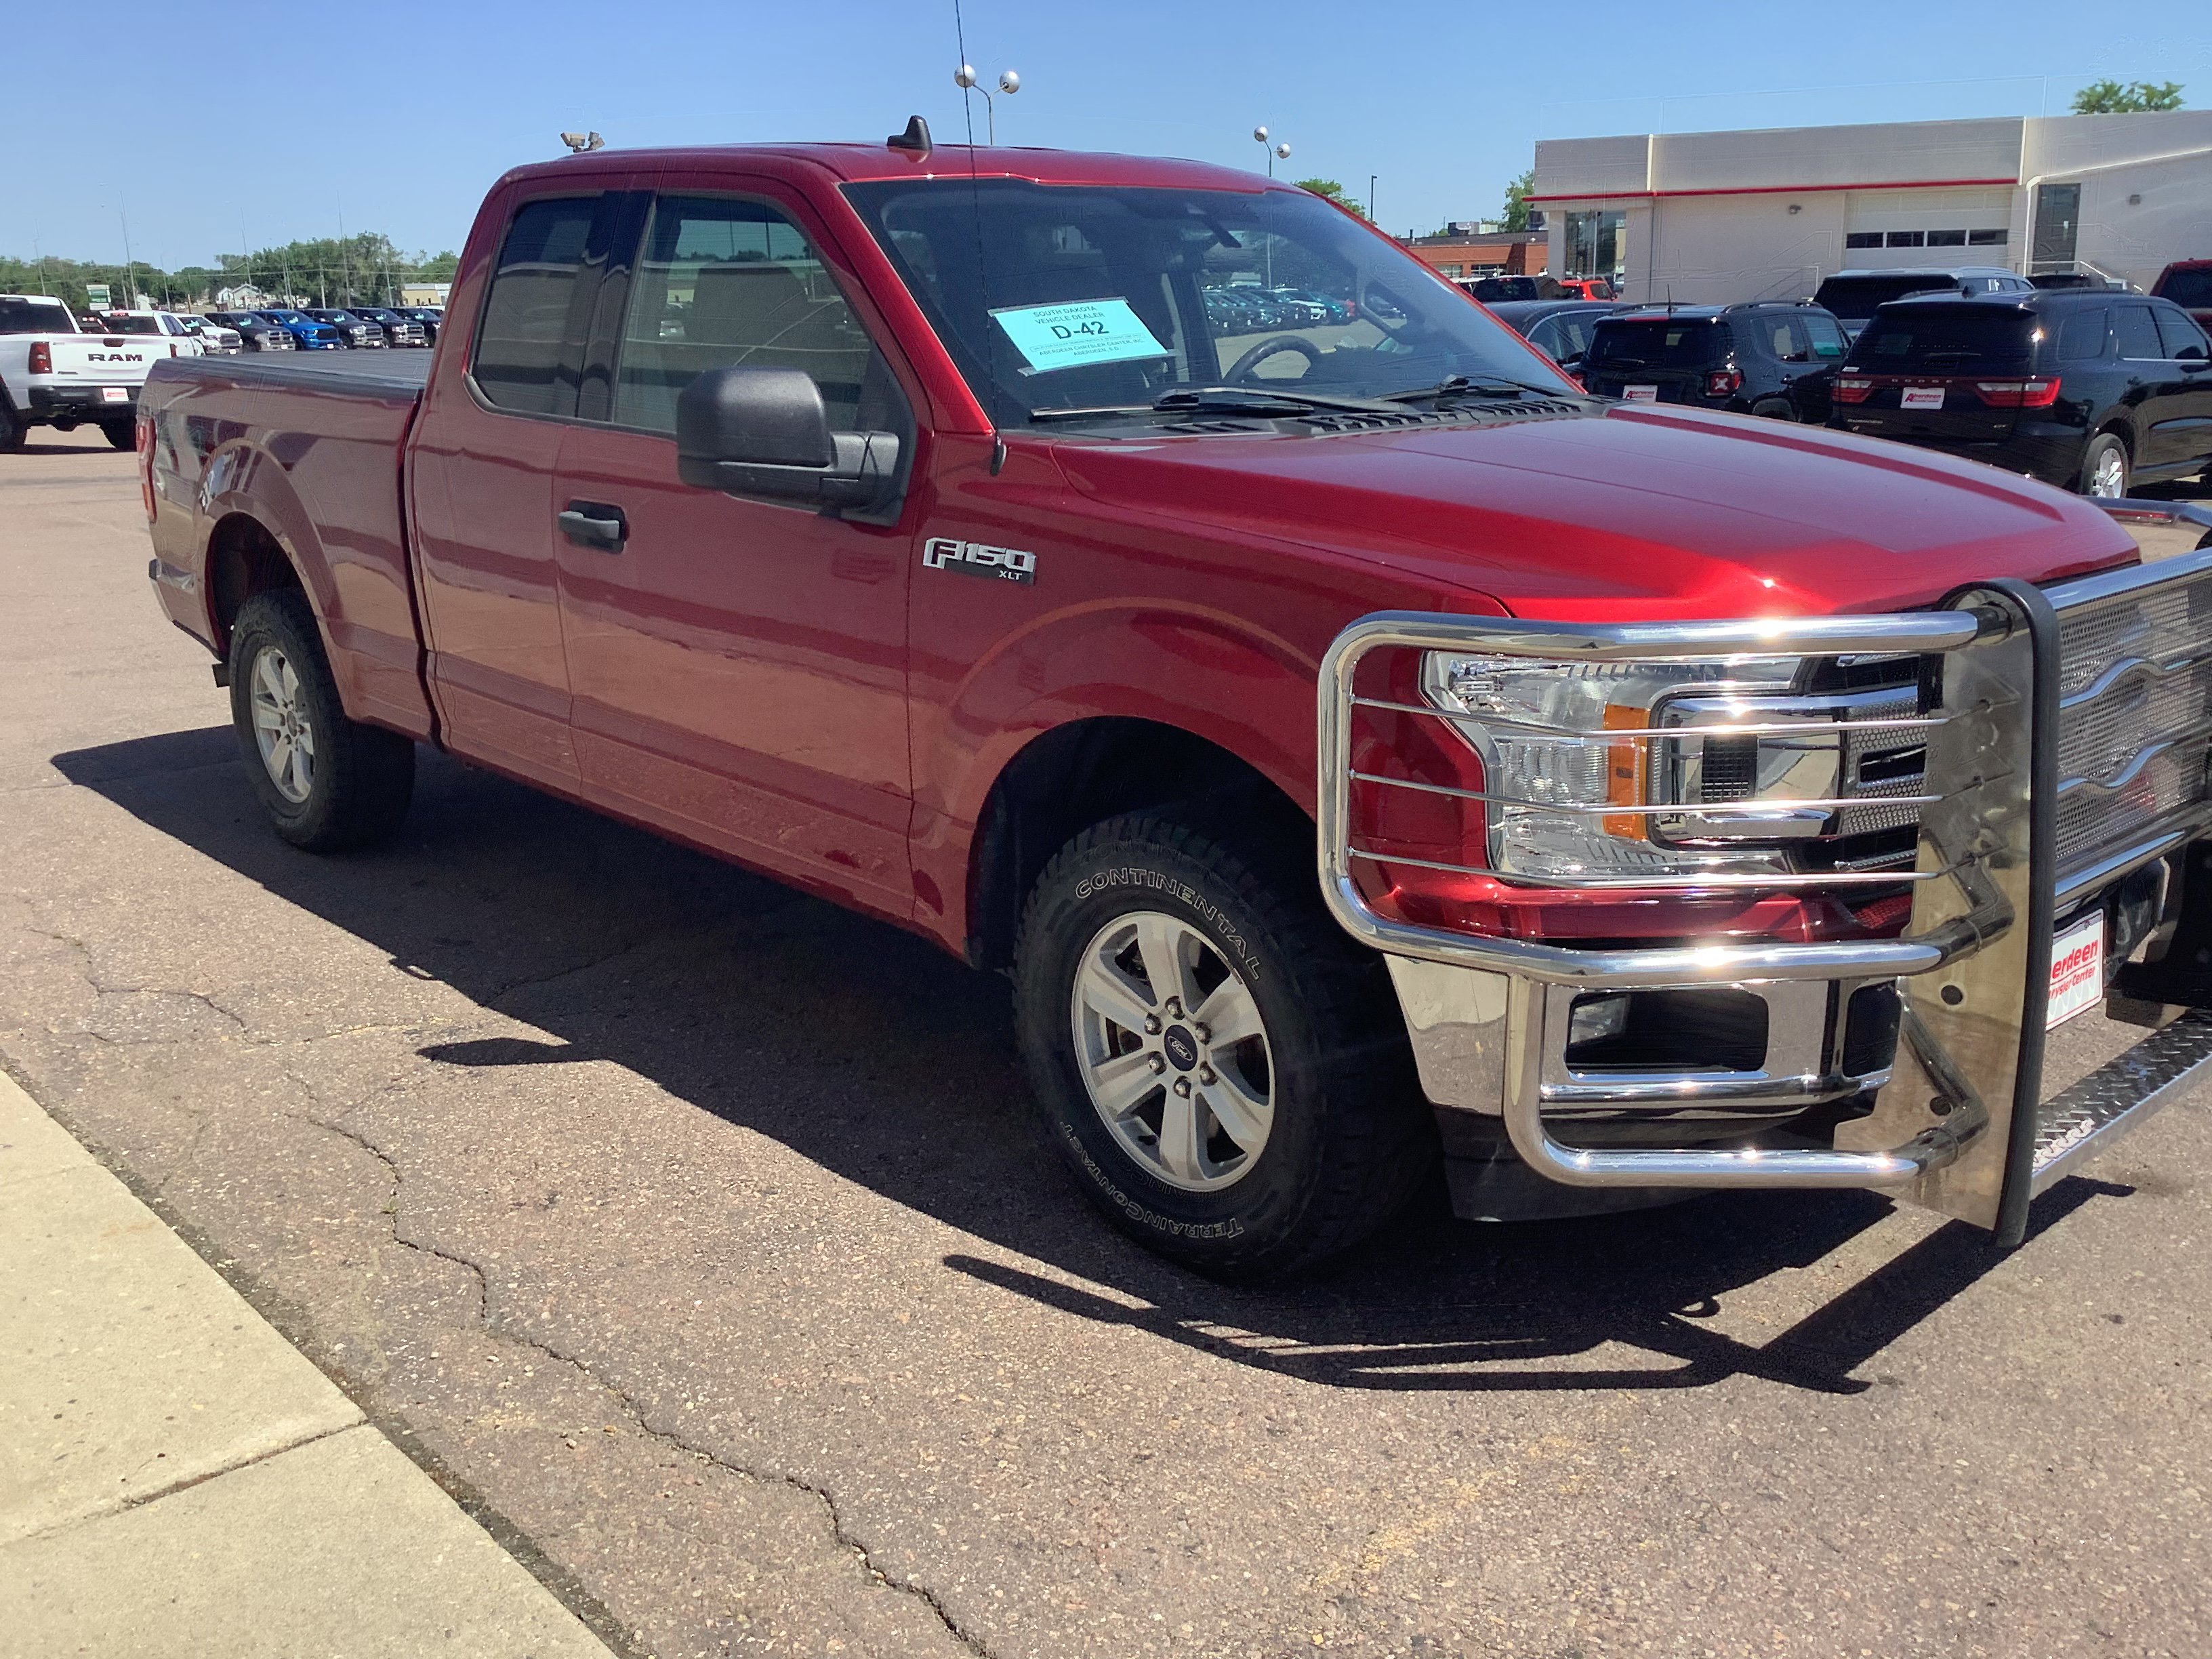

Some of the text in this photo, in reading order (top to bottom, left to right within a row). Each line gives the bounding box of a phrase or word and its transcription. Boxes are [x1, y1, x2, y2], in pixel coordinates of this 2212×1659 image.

[1033, 306, 1097, 317] SOUTH DAKOTA
[1034, 312, 1106, 324] VEHICLE DEALER
[1050, 321, 1109, 339] D-42
[87, 353, 143, 362] RAM
[998, 569, 1023, 580] XLT
[1076, 867, 1261, 981] CONTINENTAL
